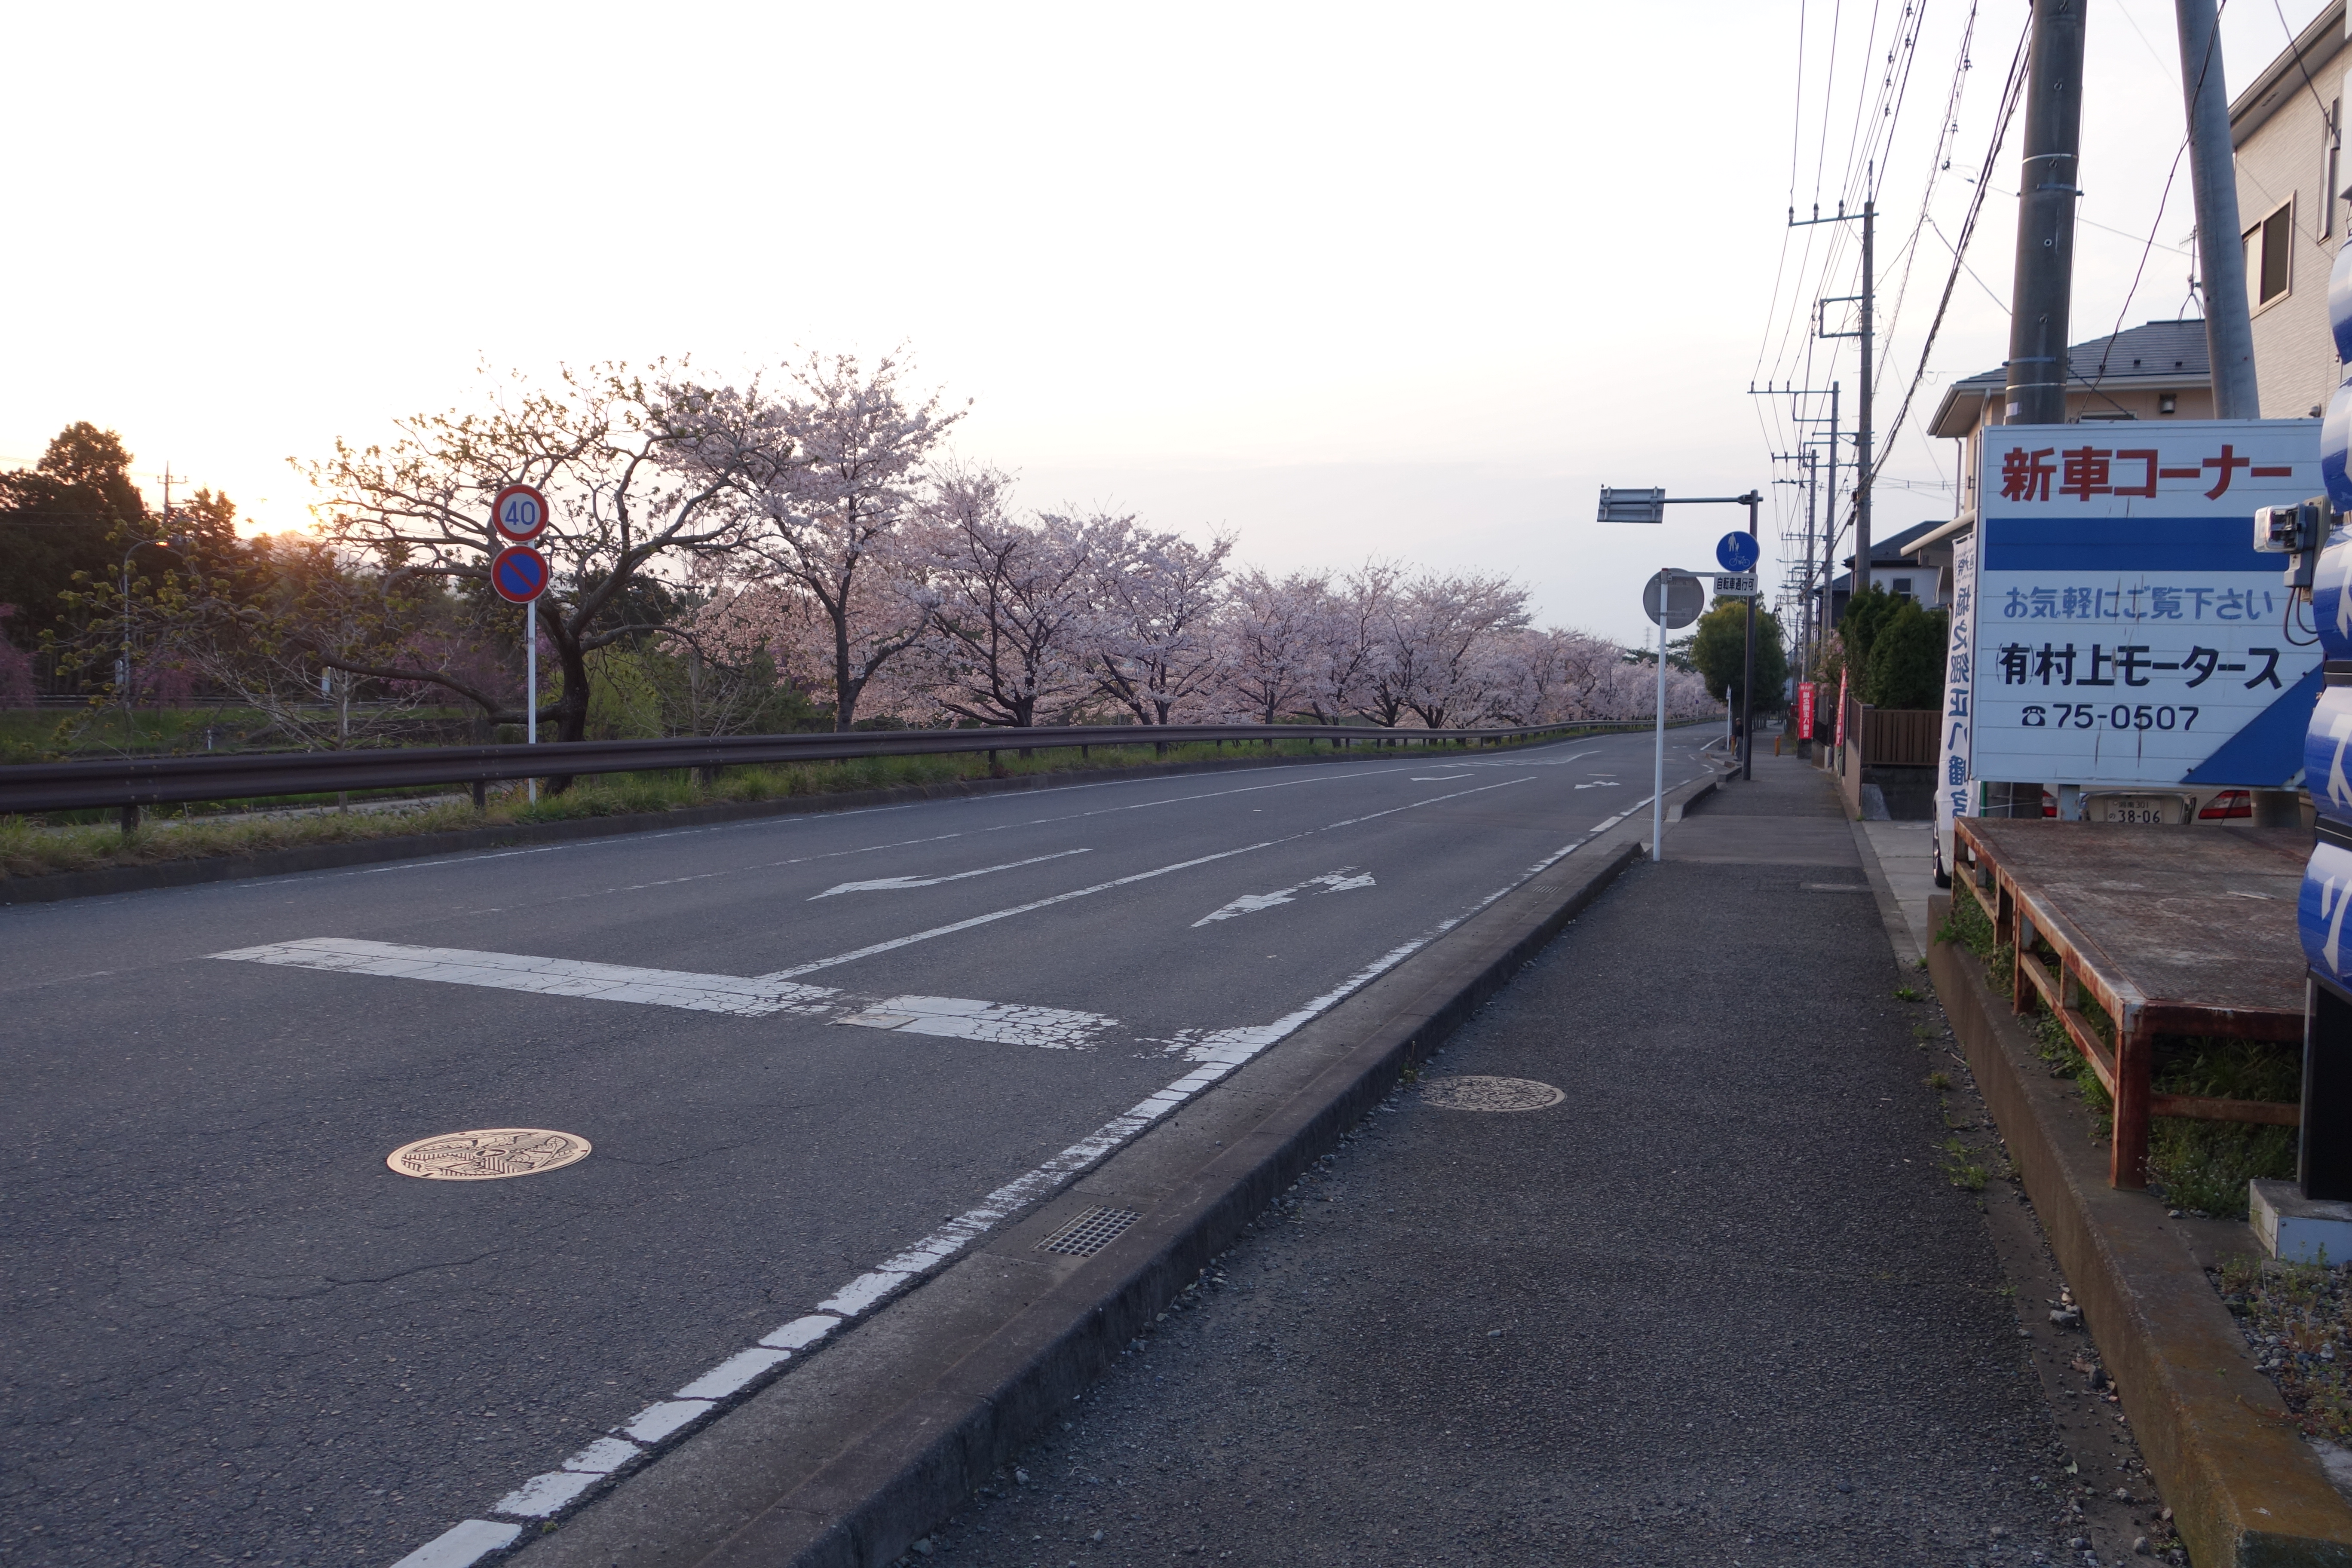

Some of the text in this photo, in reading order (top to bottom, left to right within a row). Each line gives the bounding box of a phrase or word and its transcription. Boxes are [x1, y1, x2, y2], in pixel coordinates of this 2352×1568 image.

[2000, 444, 2292, 502] 新車コーナー
[505, 501, 536, 525] 40
[1717, 577, 1755, 591] 自転車通行可
[2003, 586, 2274, 621] お気軽にご覧下さい
[2118, 809, 2160, 823] 38-06
